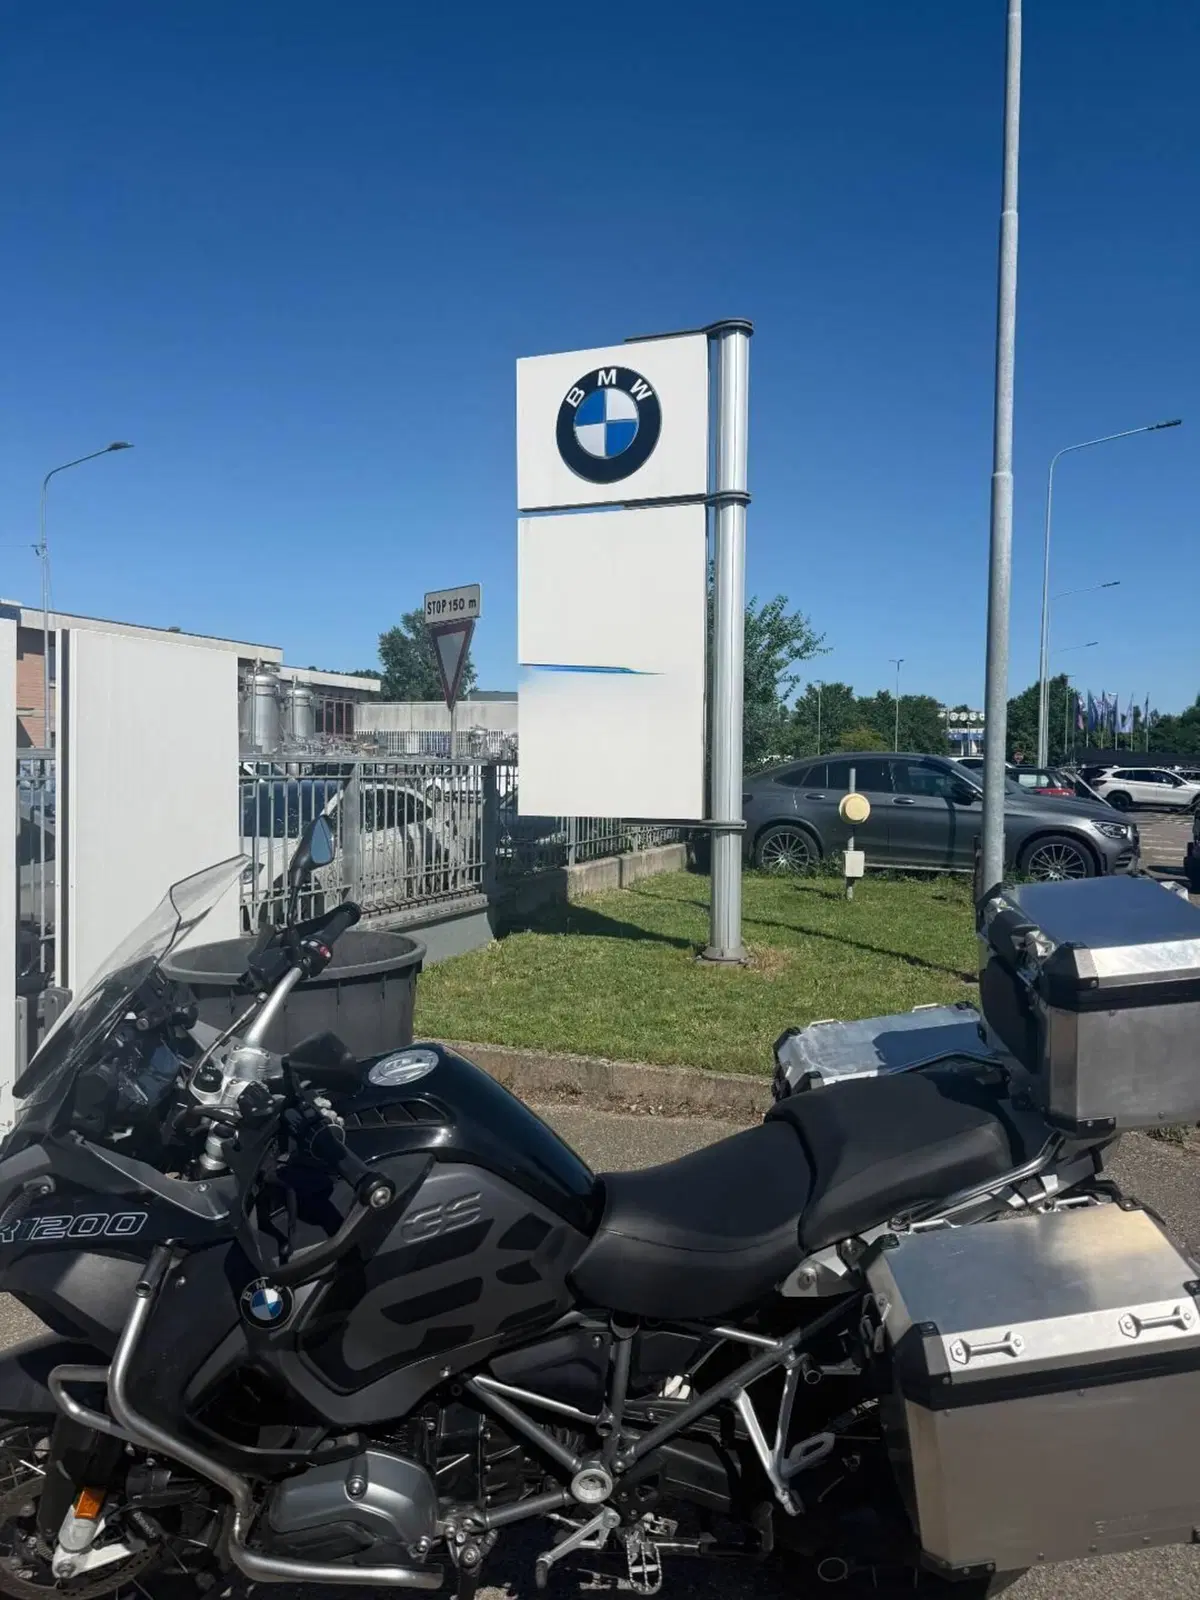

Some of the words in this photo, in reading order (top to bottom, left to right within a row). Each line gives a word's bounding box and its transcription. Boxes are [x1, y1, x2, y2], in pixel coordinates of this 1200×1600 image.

[566, 369, 652, 407] BMW
[427, 599, 446, 615] STOP
[448, 598, 465, 612] 150
[468, 599, 477, 609] m
